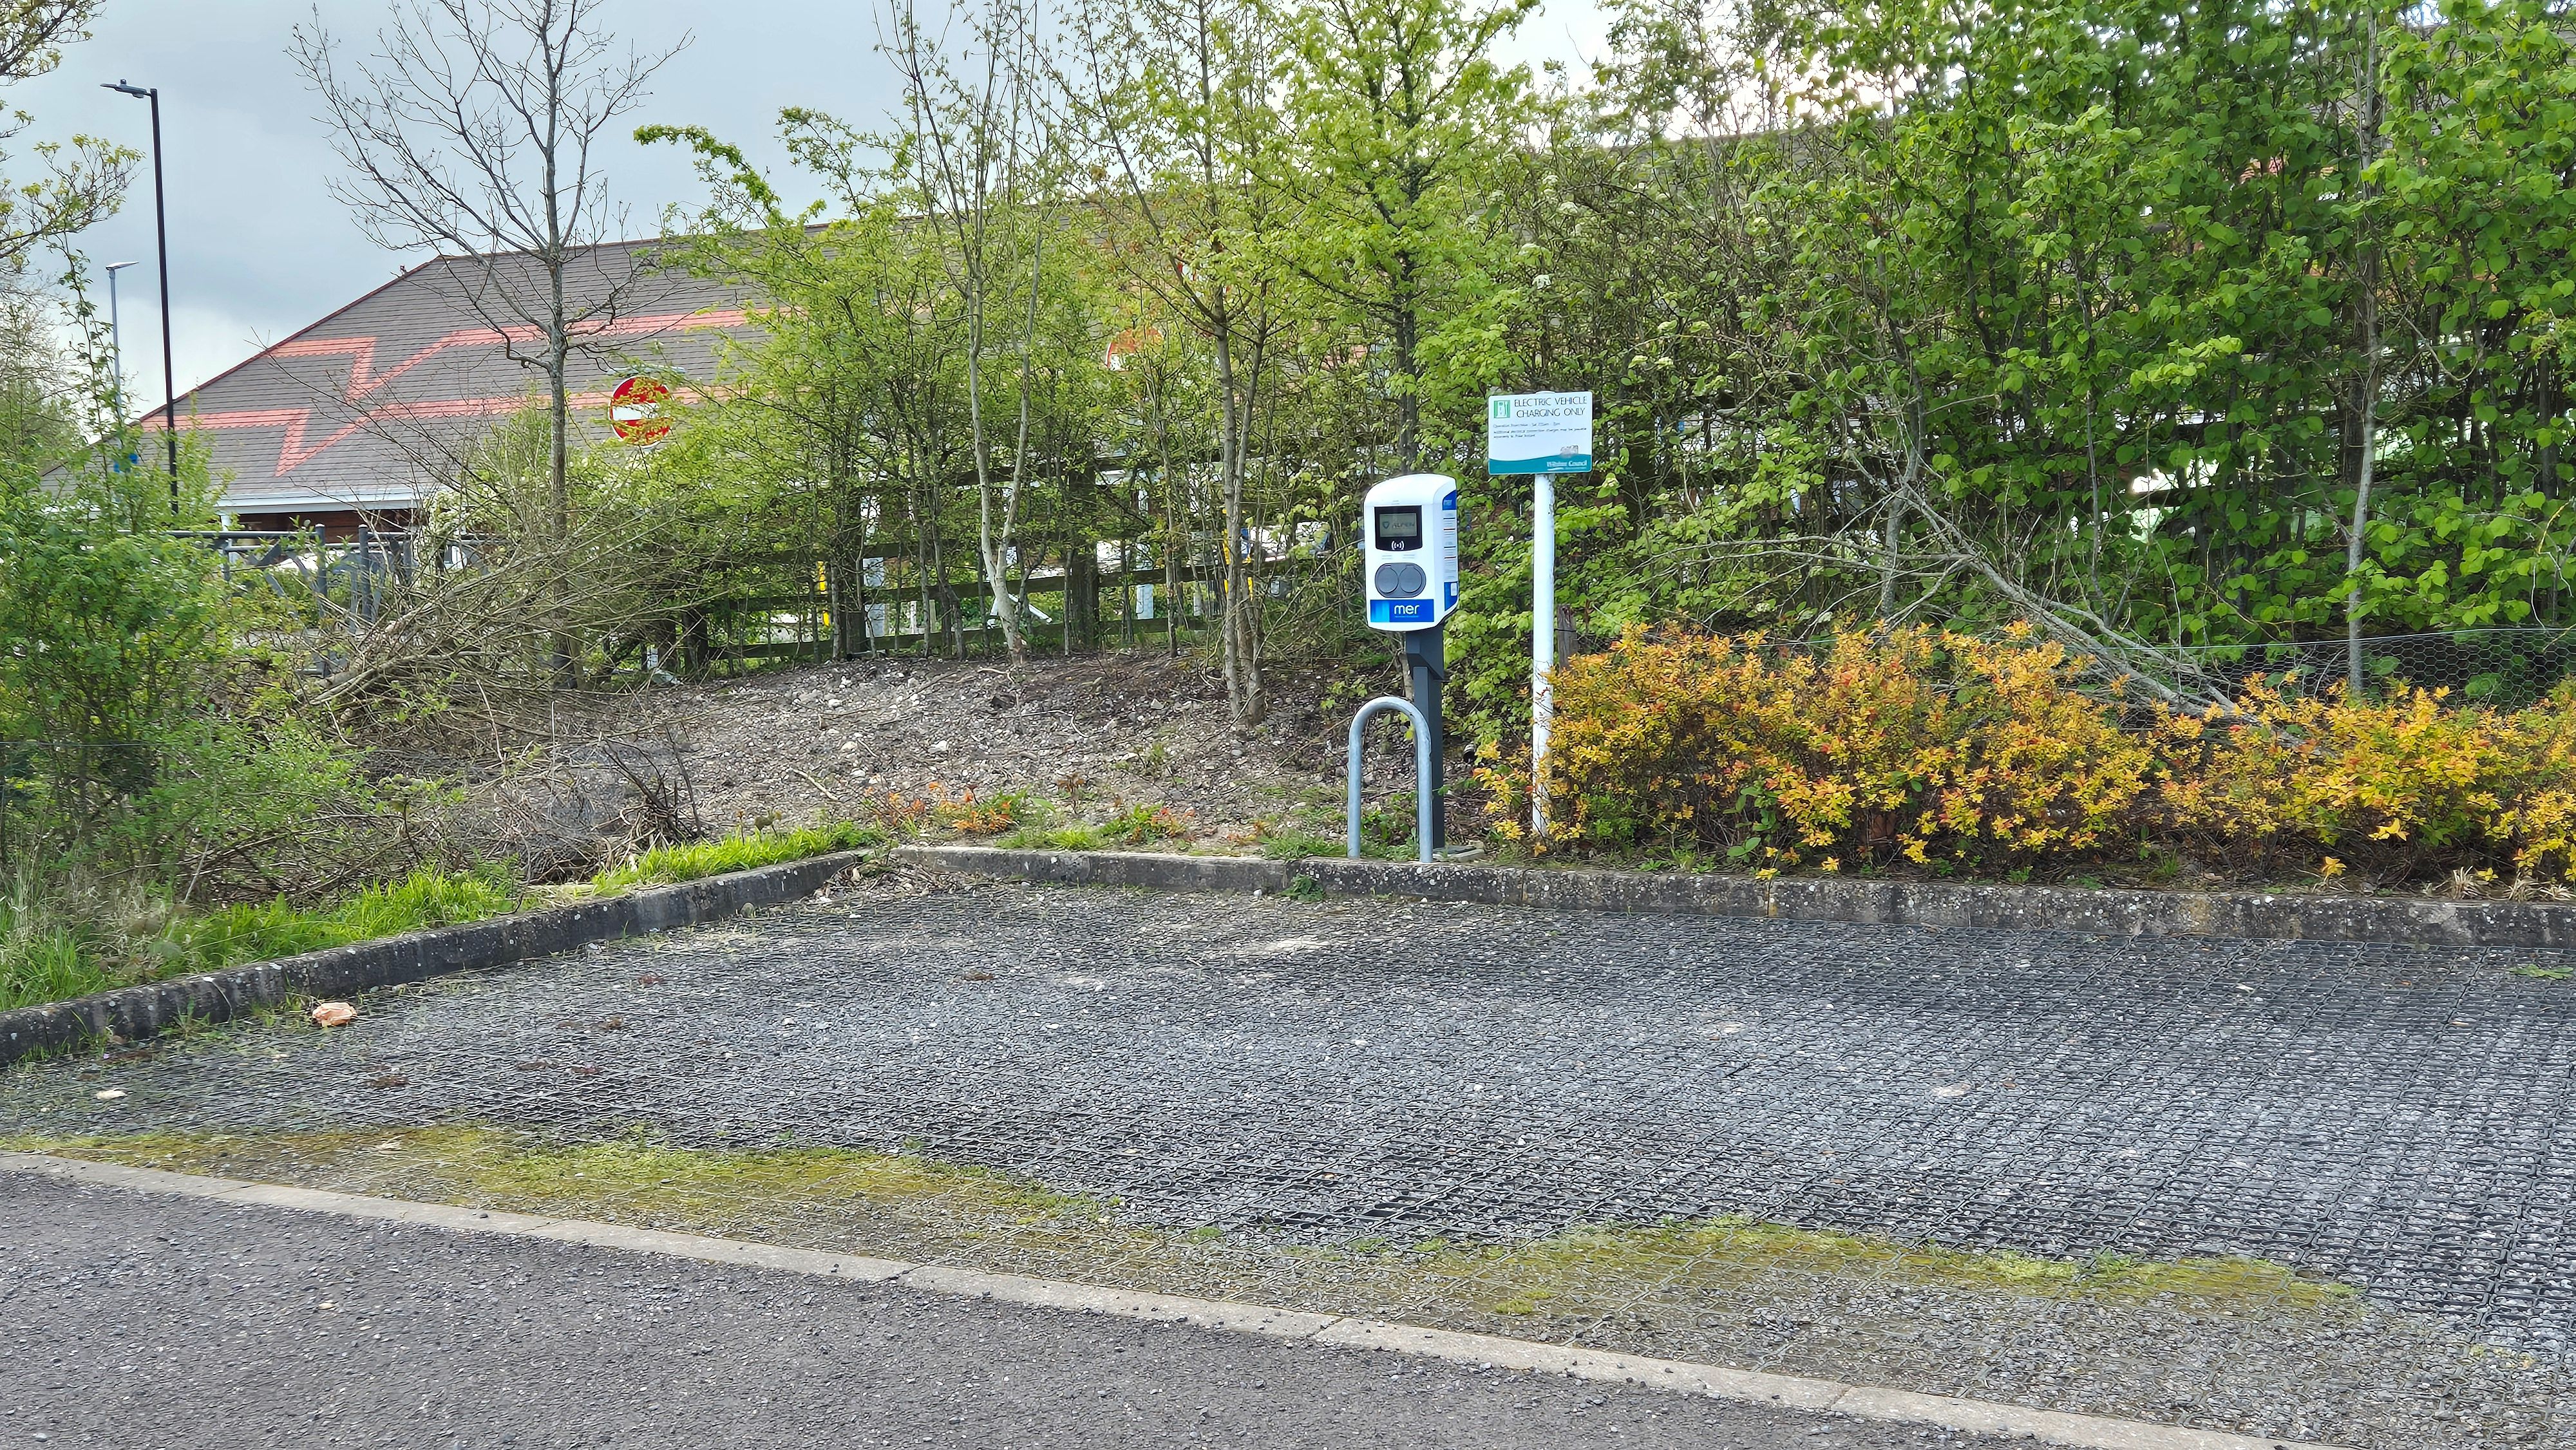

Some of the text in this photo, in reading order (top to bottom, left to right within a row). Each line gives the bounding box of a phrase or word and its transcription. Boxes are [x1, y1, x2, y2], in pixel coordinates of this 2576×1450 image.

[1514, 396, 1587, 407] ELECTRIC VEHICLE
[1517, 408, 1586, 418] CHARGING ONLY
[1394, 605, 1420, 615] mer
